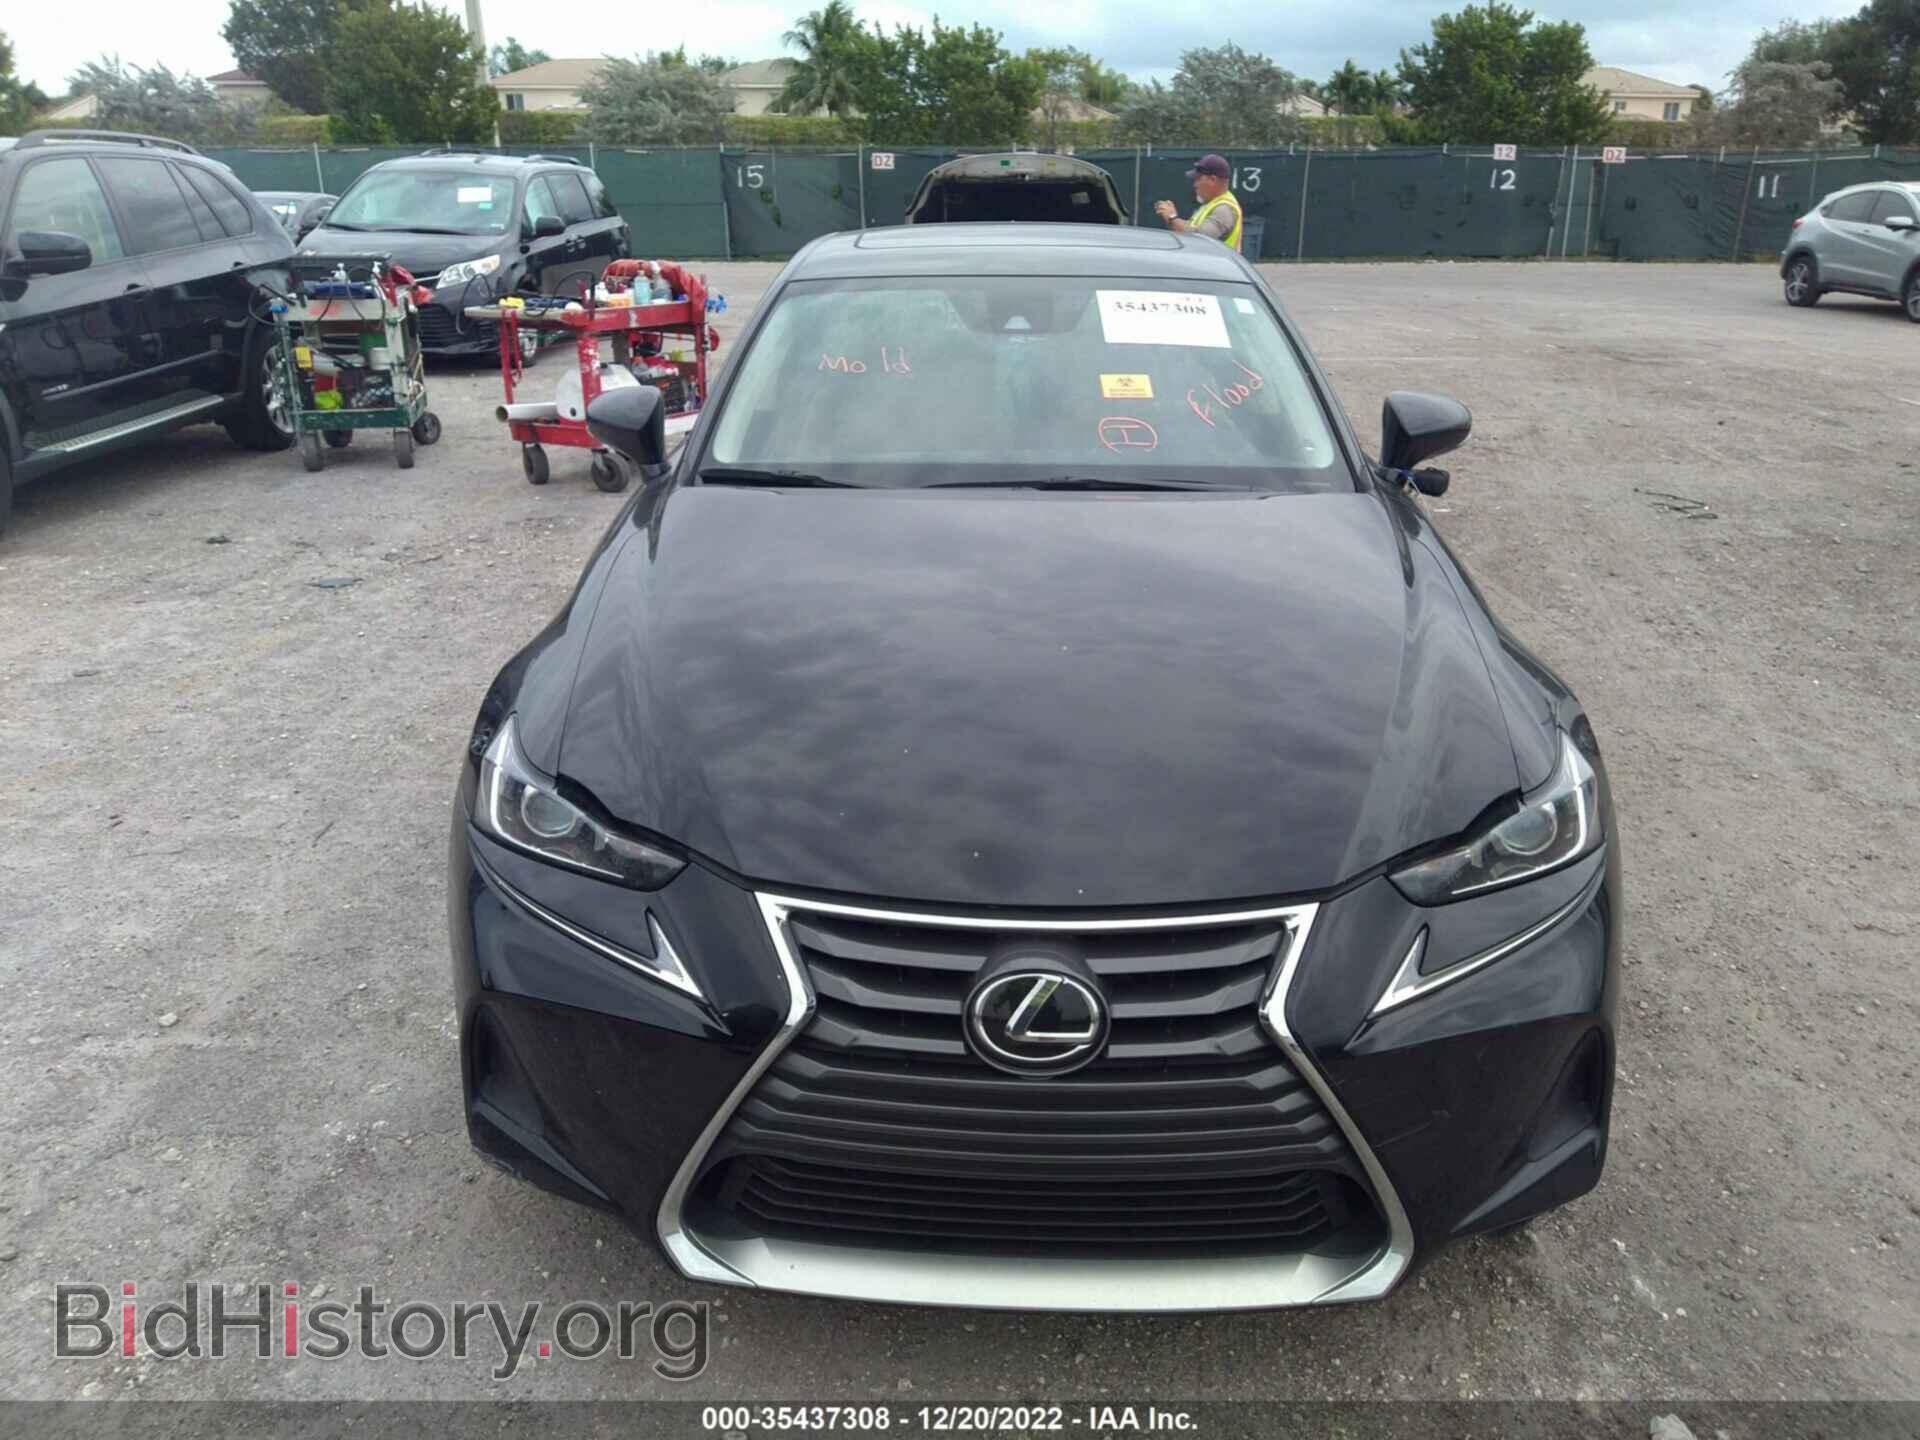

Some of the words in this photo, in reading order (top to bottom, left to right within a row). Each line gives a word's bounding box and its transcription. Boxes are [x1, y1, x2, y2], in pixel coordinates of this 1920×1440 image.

[737, 165, 764, 189] 15
[1232, 167, 1261, 192] 13
[1490, 168, 1516, 190] 12
[1758, 174, 1780, 198] 11
